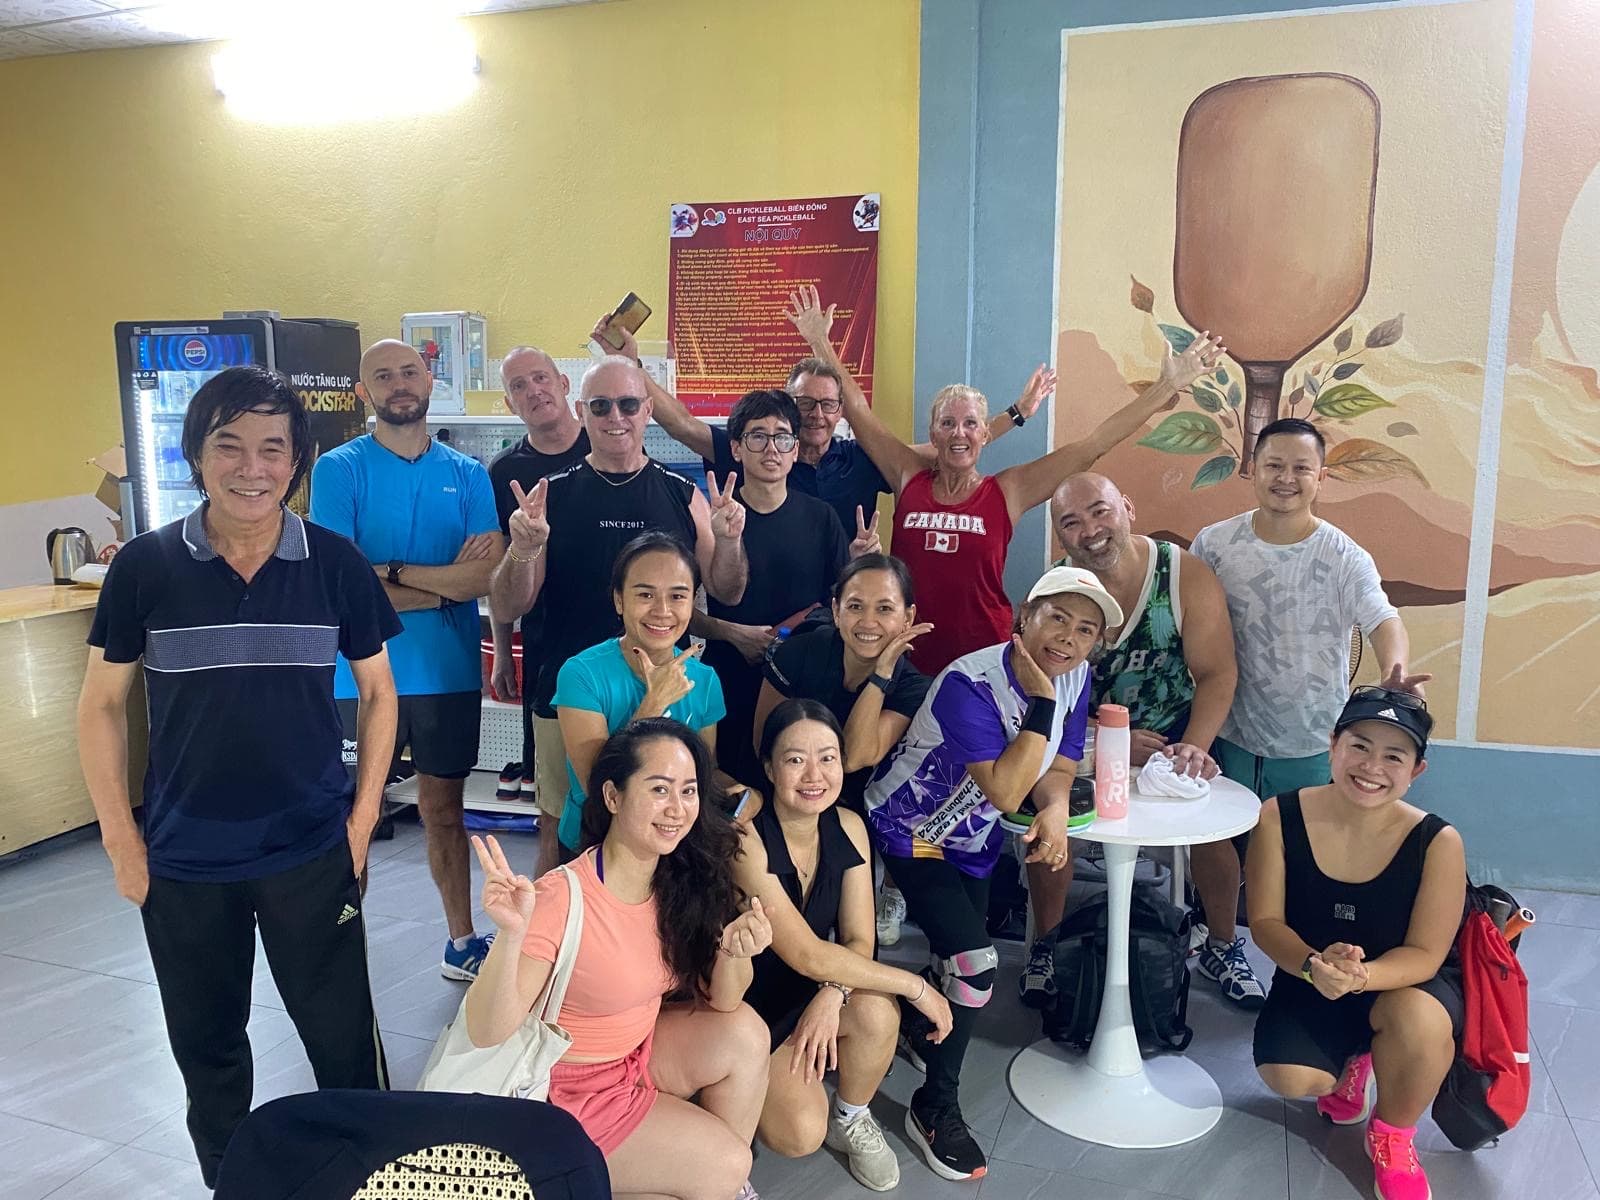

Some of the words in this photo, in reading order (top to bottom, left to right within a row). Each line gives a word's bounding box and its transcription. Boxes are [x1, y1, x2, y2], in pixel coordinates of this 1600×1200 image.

[727, 207, 742, 215] CLB
[743, 205, 787, 214] PICKLEBALL
[737, 216, 756, 224] EAST
[757, 215, 772, 223] SEA
[772, 213, 816, 222] PICKLEBALL
[744, 227, 769, 244] NỘI
[771, 227, 802, 241] QUY
[291, 372, 315, 386] NƯỚC
[336, 375, 352, 390] LỰC
[298, 390, 357, 412] OCKSTAR
[903, 511, 987, 536] CANADA
[928, 814, 958, 843] Learn
